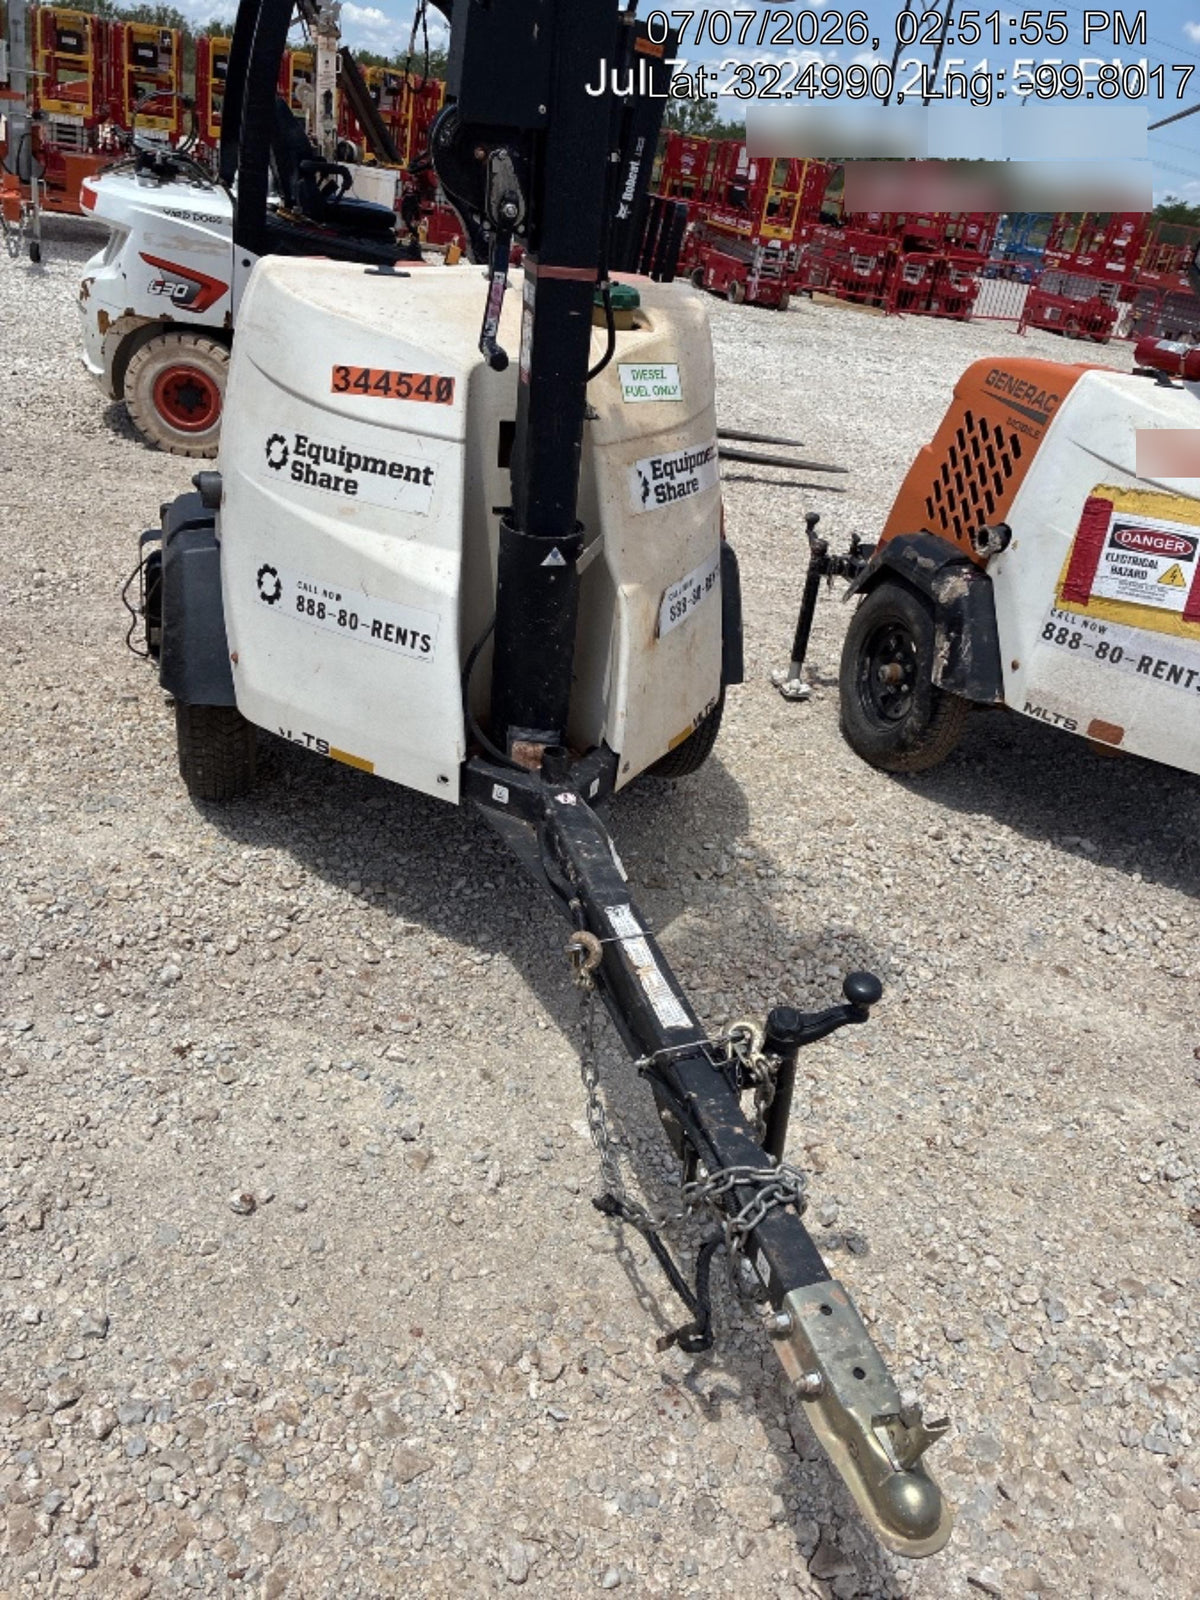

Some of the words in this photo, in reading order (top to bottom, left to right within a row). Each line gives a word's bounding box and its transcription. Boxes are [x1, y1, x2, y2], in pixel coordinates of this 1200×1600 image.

[621, 161, 641, 202] Bobcat
[147, 280, 190, 298] G30
[333, 366, 454, 403] 344540
[631, 366, 667, 380] DIESEL
[625, 385, 650, 397] FUEL
[652, 385, 678, 396] ONLY
[985, 368, 1059, 413] GENERAC
[293, 433, 435, 486] Equipment
[291, 460, 358, 495] Share
[654, 477, 699, 504] Share
[1121, 531, 1185, 552] DANGER
[1105, 552, 1158, 569] ELECTRICAL
[1111, 565, 1148, 580] HAZARD
[297, 580, 318, 595] CALL
[323, 589, 342, 602] NOW
[296, 594, 432, 653] 888-80-RENTS
[1050, 608, 1076, 625] CALL
[1081, 619, 1108, 636] NOW
[1023, 701, 1079, 732] MLTS
